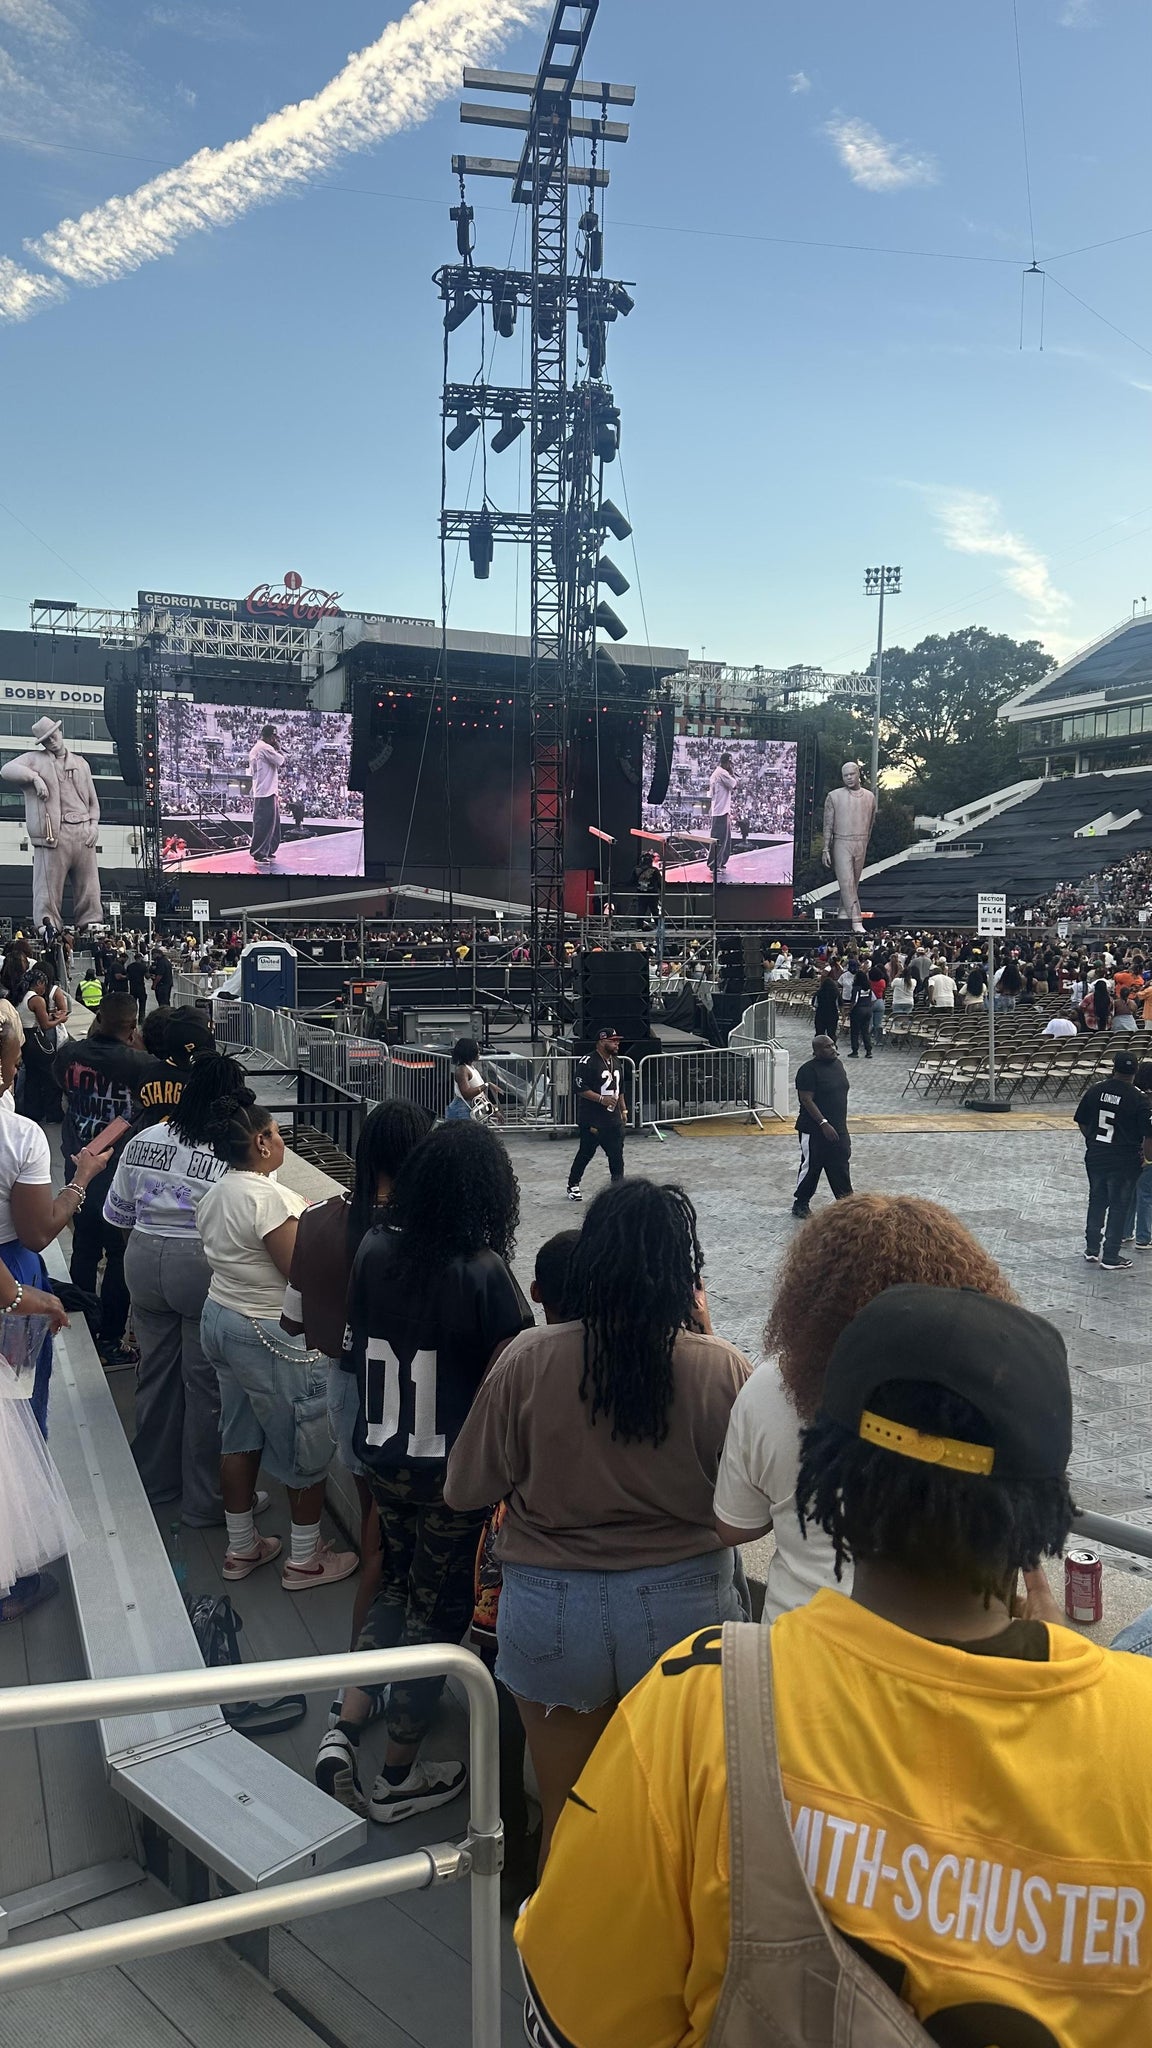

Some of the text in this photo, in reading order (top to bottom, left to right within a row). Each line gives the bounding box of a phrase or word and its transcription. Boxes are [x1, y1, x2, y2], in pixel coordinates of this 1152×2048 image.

[144, 594, 237, 611] GEORGIA TECH
[5, 687, 103, 704] BOBBY DODD
[68, 1066, 128, 1101] LOVE
[140, 1081, 187, 1108] STARG
[601, 1069, 620, 1100] 21
[1100, 1092, 1122, 1106] LONDON
[1096, 1109, 1116, 1143] 5
[126, 1141, 229, 1183] BREEZY BOW
[311, 1853, 316, 1867] 1
[784, 1799, 1146, 1967] MITH-SCHUSTER
